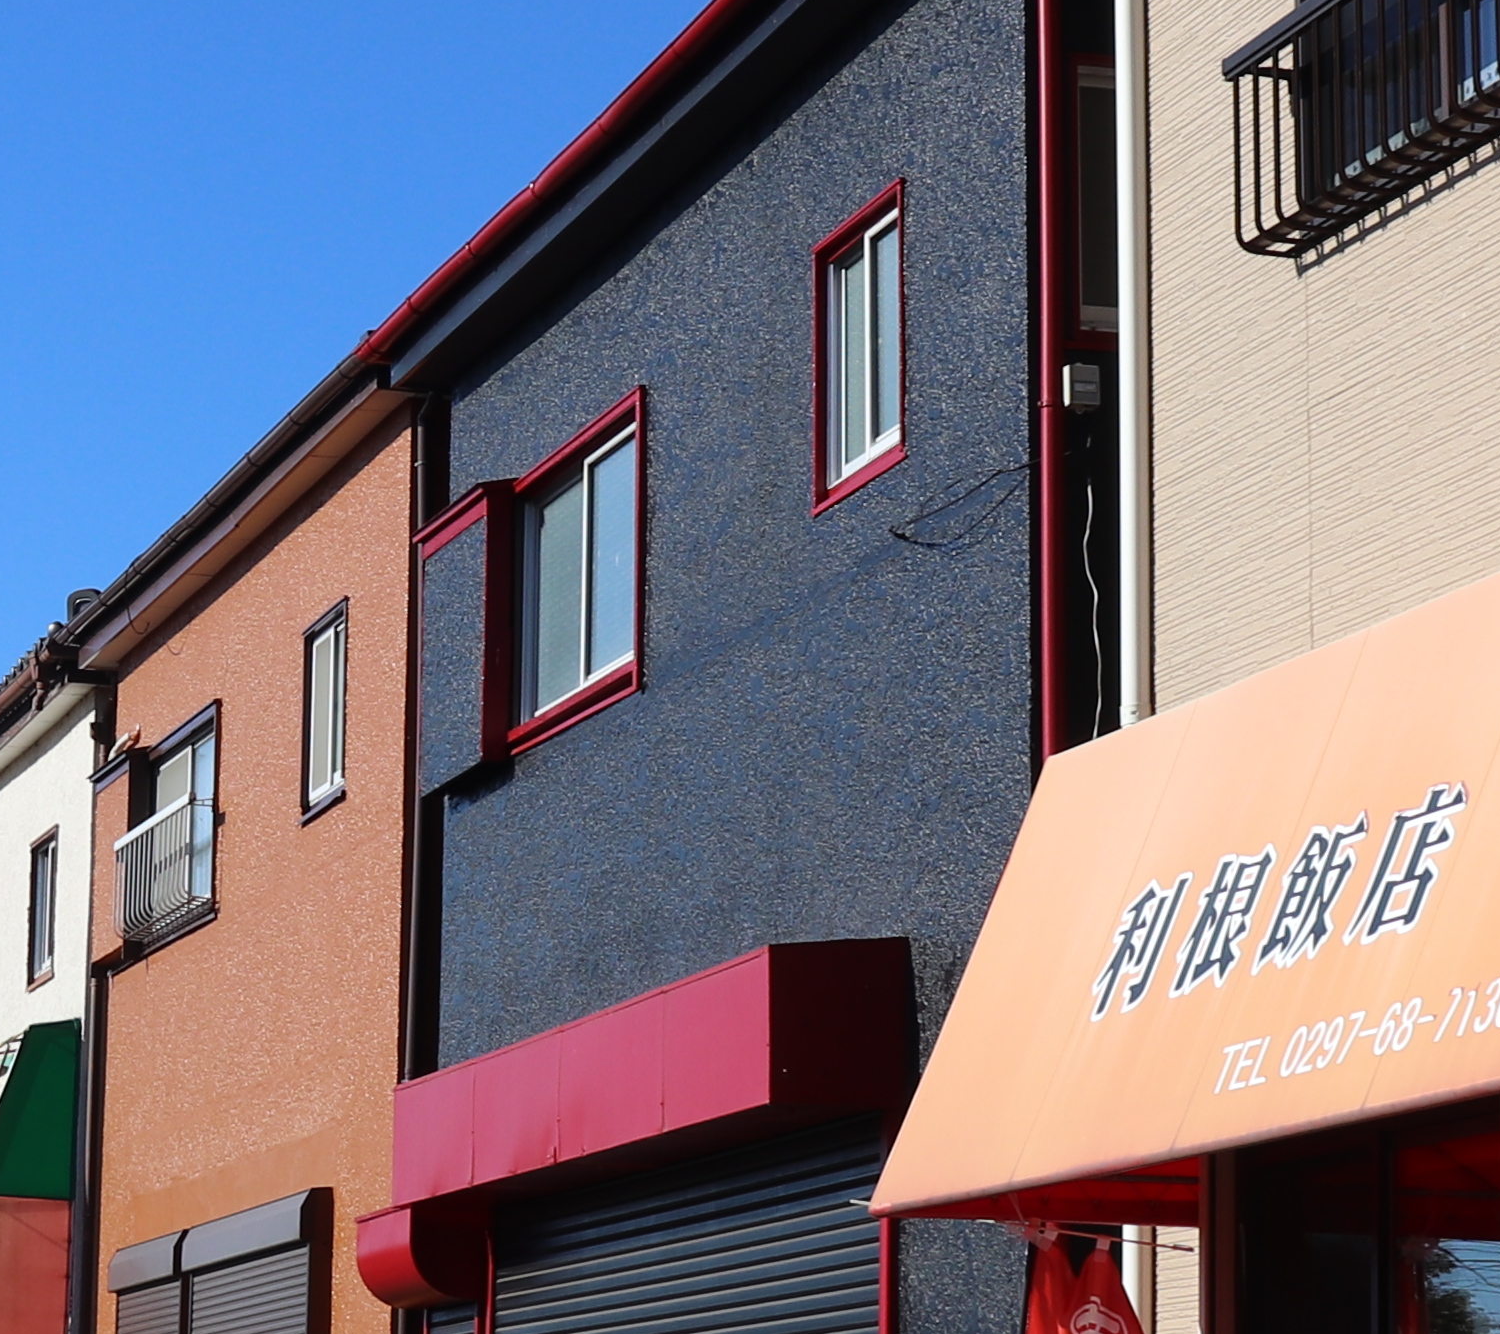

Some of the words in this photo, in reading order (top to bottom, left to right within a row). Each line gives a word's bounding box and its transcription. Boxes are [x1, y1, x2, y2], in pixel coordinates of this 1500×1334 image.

[1090, 782, 1467, 1021] 利根飯店
[1213, 1036, 1268, 1095] TEL
